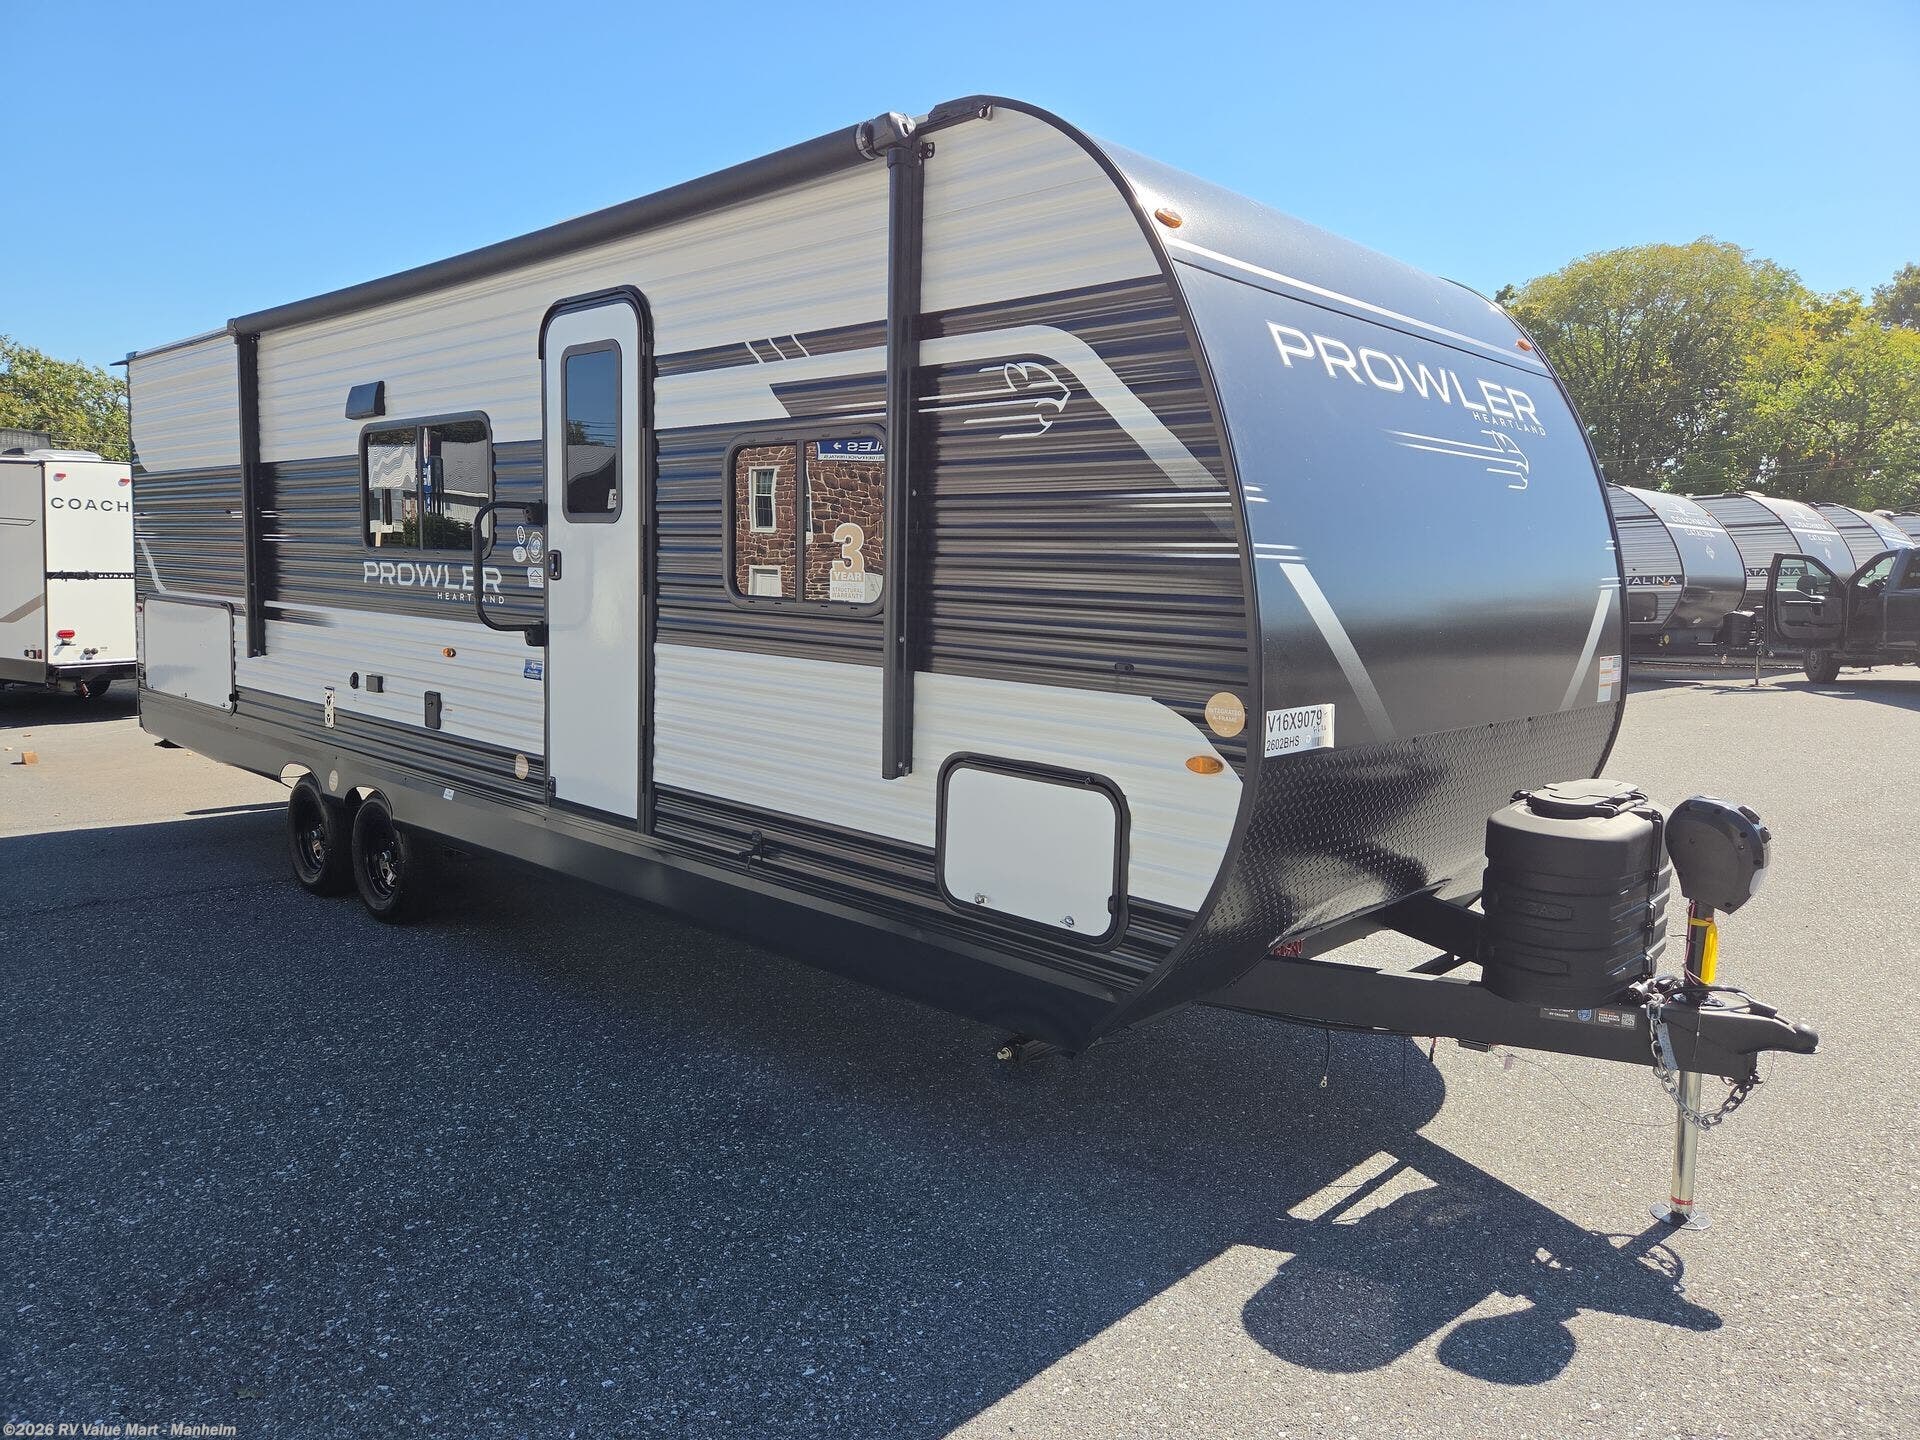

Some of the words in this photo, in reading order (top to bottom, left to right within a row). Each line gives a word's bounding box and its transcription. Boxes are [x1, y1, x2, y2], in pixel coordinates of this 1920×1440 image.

[1266, 320, 1543, 426] PROWLER
[1472, 411, 1546, 436] HEARTLAND
[51, 497, 129, 512] COACH
[833, 523, 865, 571] 3
[363, 561, 503, 593] PROWLER
[833, 571, 861, 581] YEAR
[437, 592, 505, 605] HEARTAND
[1267, 709, 1323, 733] V16X9079
[1266, 735, 1300, 751] 2602BHS
